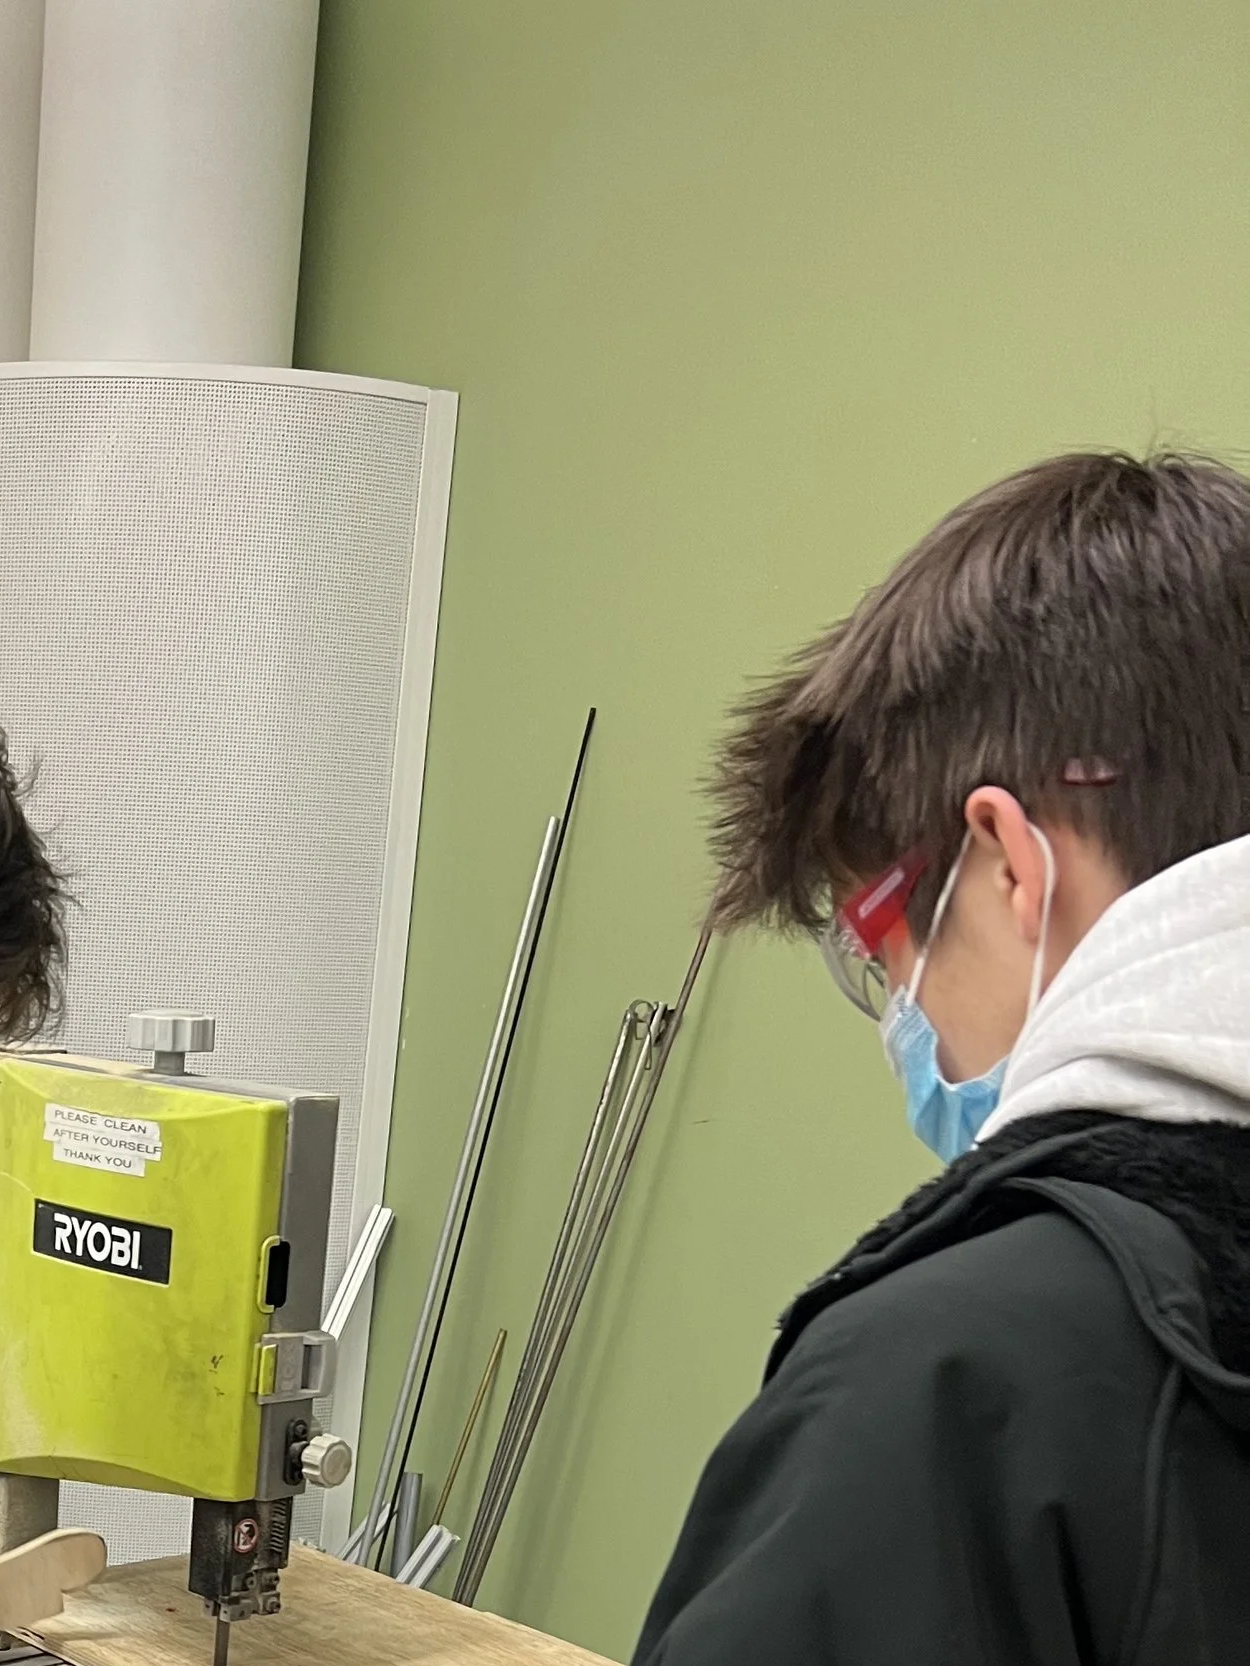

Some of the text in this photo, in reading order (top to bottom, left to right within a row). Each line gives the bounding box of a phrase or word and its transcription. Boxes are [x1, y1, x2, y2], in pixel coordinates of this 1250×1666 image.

[54, 1109, 147, 1134] PLEASE CLEAN
[53, 1128, 162, 1155] AFTER YOURSELF
[63, 1148, 132, 1168] THANK YOU
[53, 1212, 141, 1270] RYOBI
